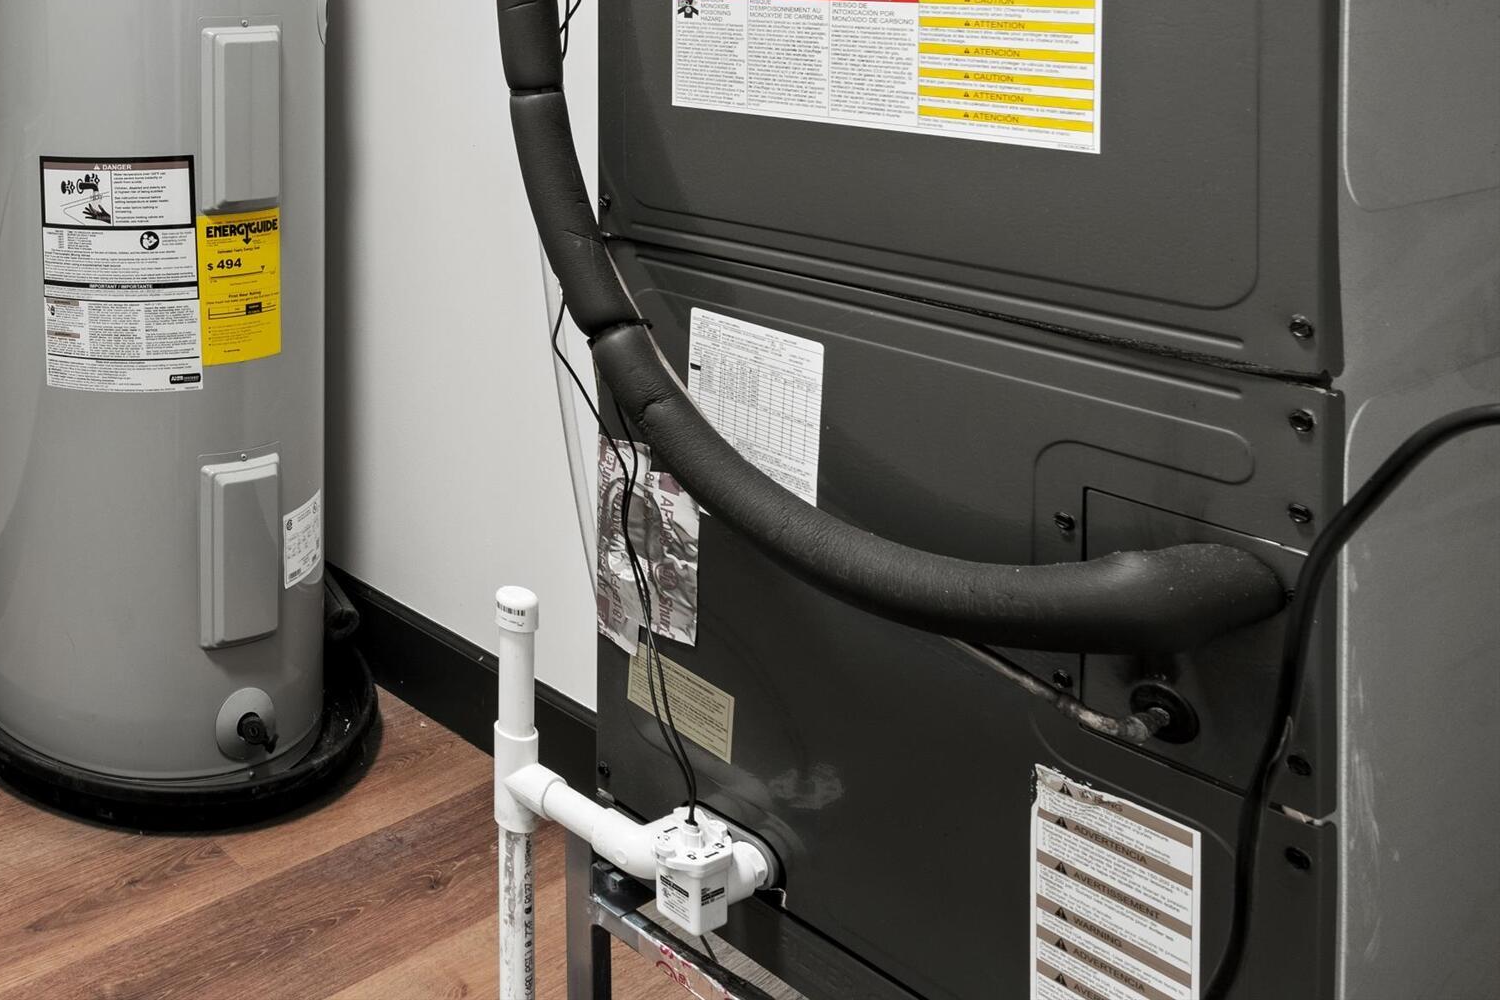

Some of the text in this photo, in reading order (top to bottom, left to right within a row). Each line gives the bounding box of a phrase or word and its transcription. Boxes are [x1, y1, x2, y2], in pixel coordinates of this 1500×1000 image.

[831, 1, 858, 9] RIESGO
[879, 17, 915, 25] CARBONO
[972, 19, 1027, 31] ATTENTION
[972, 72, 1015, 83] CAUTION
[972, 90, 1025, 103] ATTENTION
[101, 162, 133, 171] DANGER
[205, 218, 279, 239] ENERGYGUIDE
[207, 258, 243, 271] $ 494
[1073, 824, 1149, 866] ADVERTENCIA
[1073, 871, 1162, 920] AVERTISSEMENT
[1073, 915, 1124, 949] WARNING
[1073, 947, 1146, 993] ADVERTENCIA
